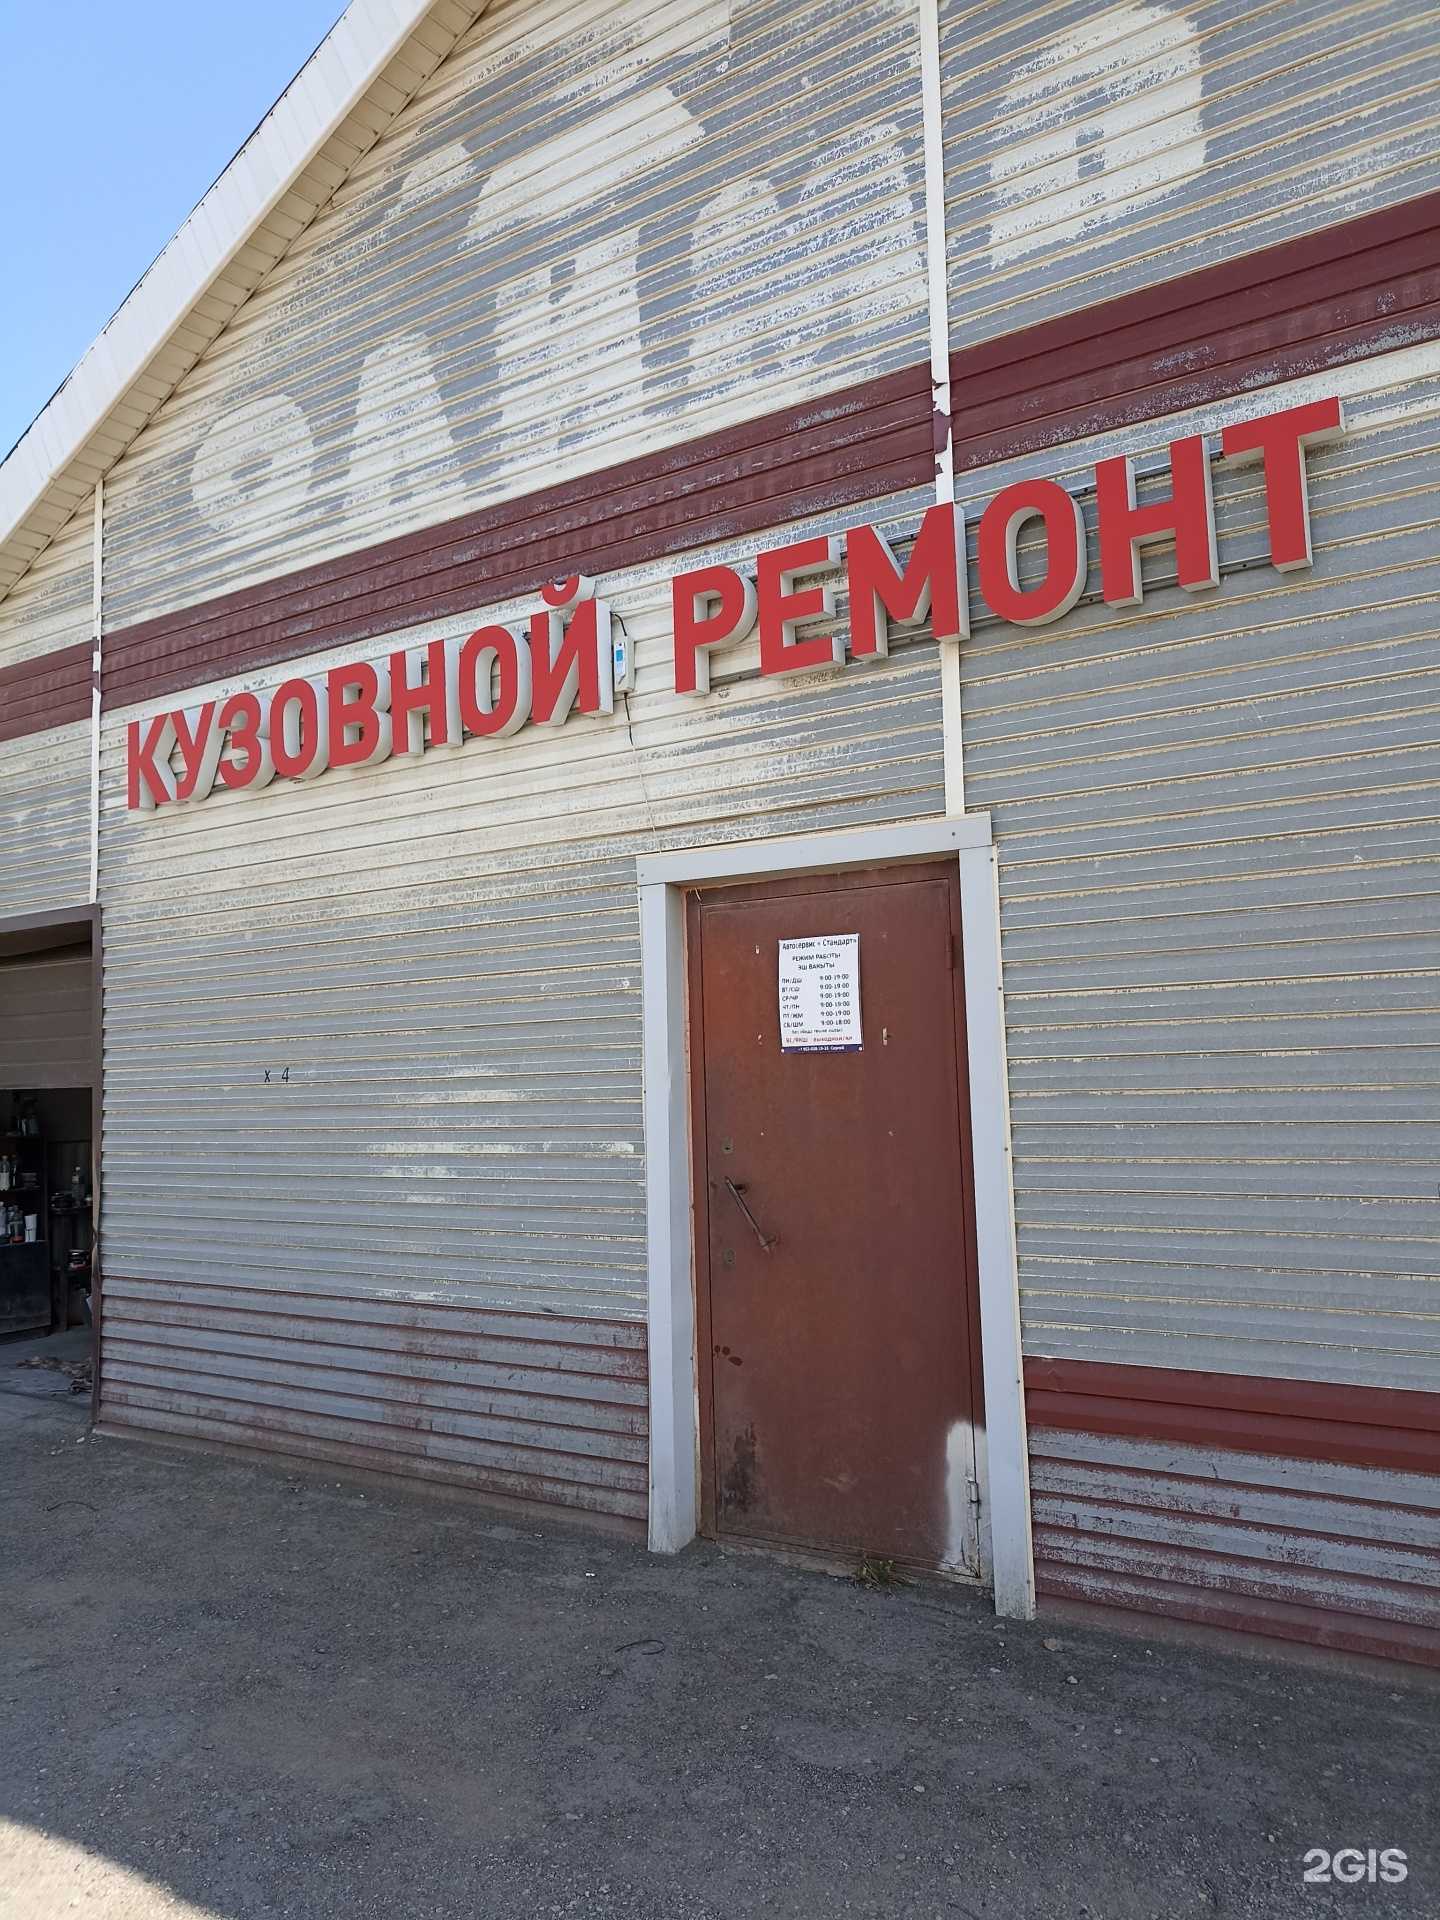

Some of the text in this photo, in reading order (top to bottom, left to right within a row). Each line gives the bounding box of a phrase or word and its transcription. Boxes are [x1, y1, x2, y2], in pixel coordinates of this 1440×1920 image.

[127, 396, 1345, 811] КУЗОВНОЙ РЕМОНТ
[782, 942, 816, 950] Автосервис
[792, 952, 841, 962] РЕЖИМ РАБОТЫ
